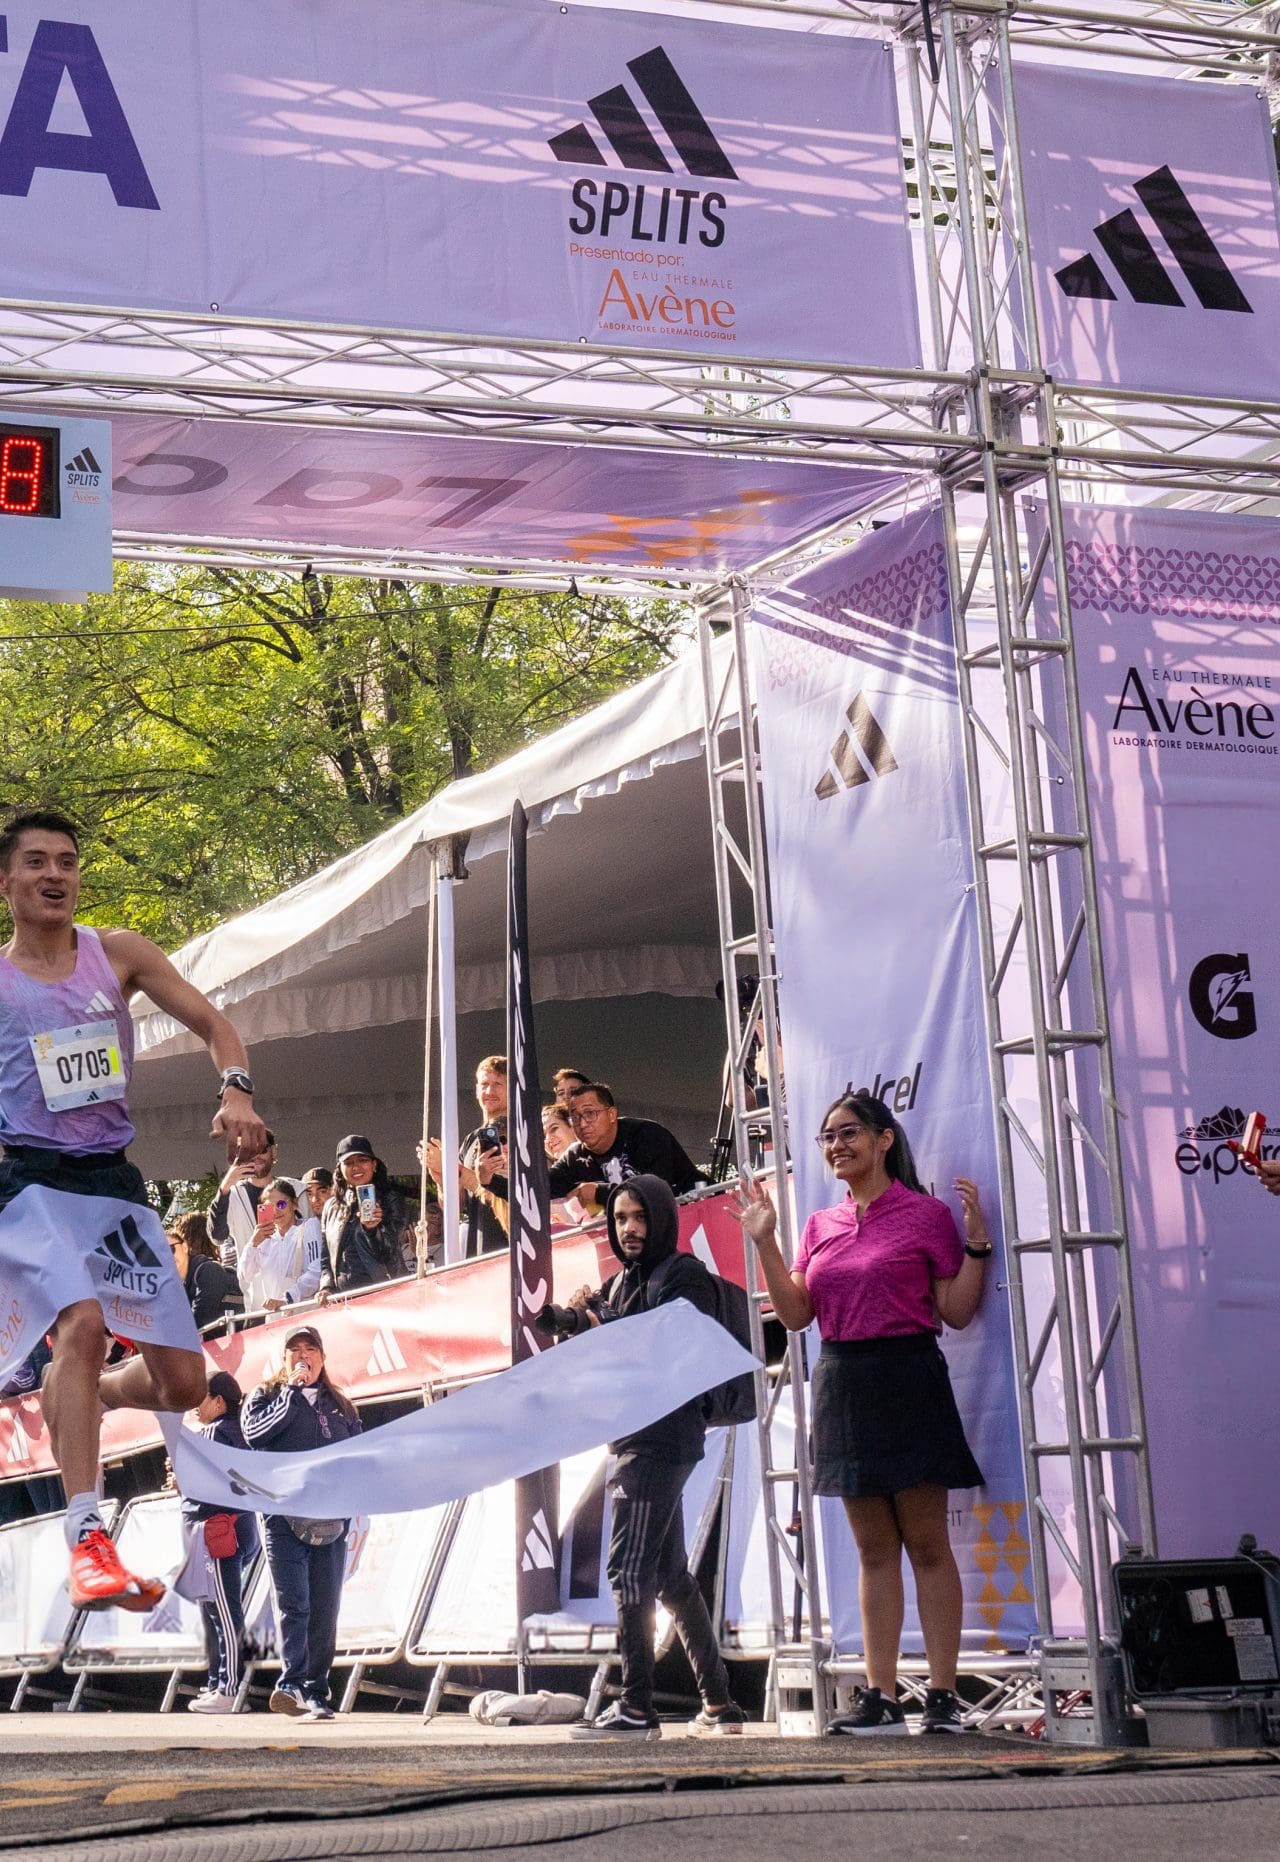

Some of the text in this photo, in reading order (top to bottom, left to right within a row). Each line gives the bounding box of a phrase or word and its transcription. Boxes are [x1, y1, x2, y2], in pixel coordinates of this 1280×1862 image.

[569, 178, 727, 248] SPLITS
[569, 243, 686, 268] Presentado por:
[632, 271, 733, 289] EAU THERMALE
[598, 268, 736, 328] Avène
[599, 322, 737, 341] LABORATOIRE DERMATOLOGIQUE
[67, 473, 100, 487] SPLITS
[1152, 669, 1272, 688] EAU THERMALE
[1113, 666, 1275, 740] Avène
[1113, 737, 1279, 755] LABORATOIRE DERMATOLOGIQUE
[56, 1047, 111, 1085] 0705
[103, 1259, 158, 1295] SPLITS
